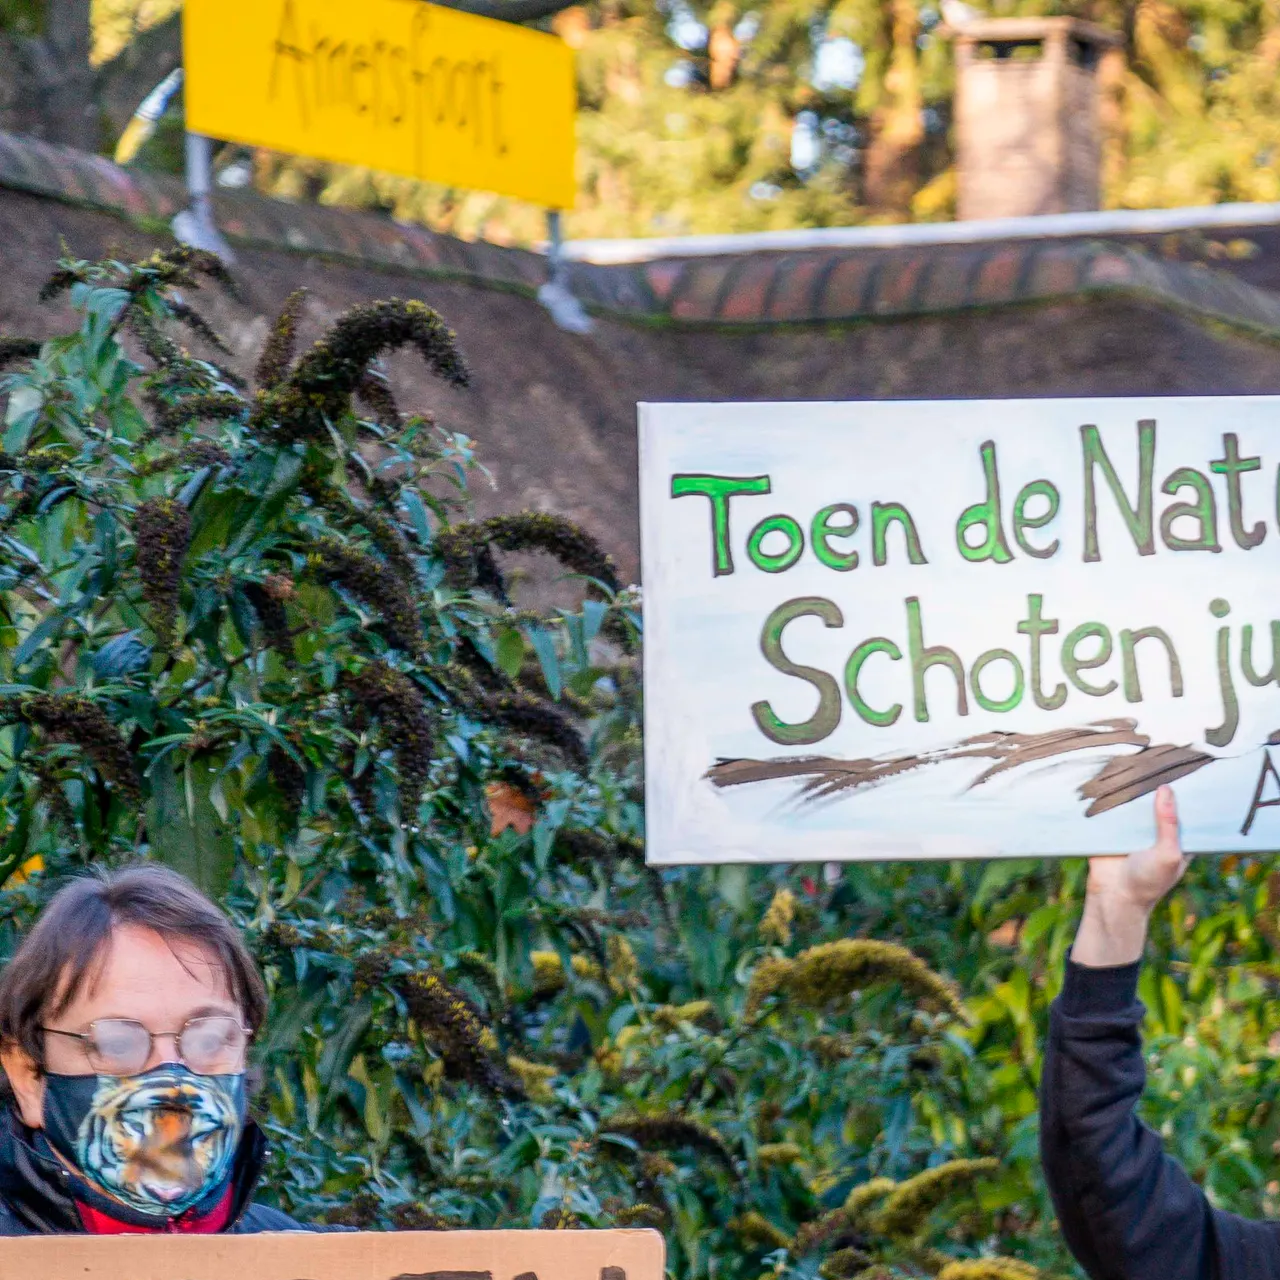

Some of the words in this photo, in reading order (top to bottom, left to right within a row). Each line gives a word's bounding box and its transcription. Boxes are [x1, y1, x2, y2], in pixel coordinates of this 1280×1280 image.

[671, 472, 928, 578] Toen
[956, 439, 1061, 564] de
[751, 593, 1184, 746] Schoten
